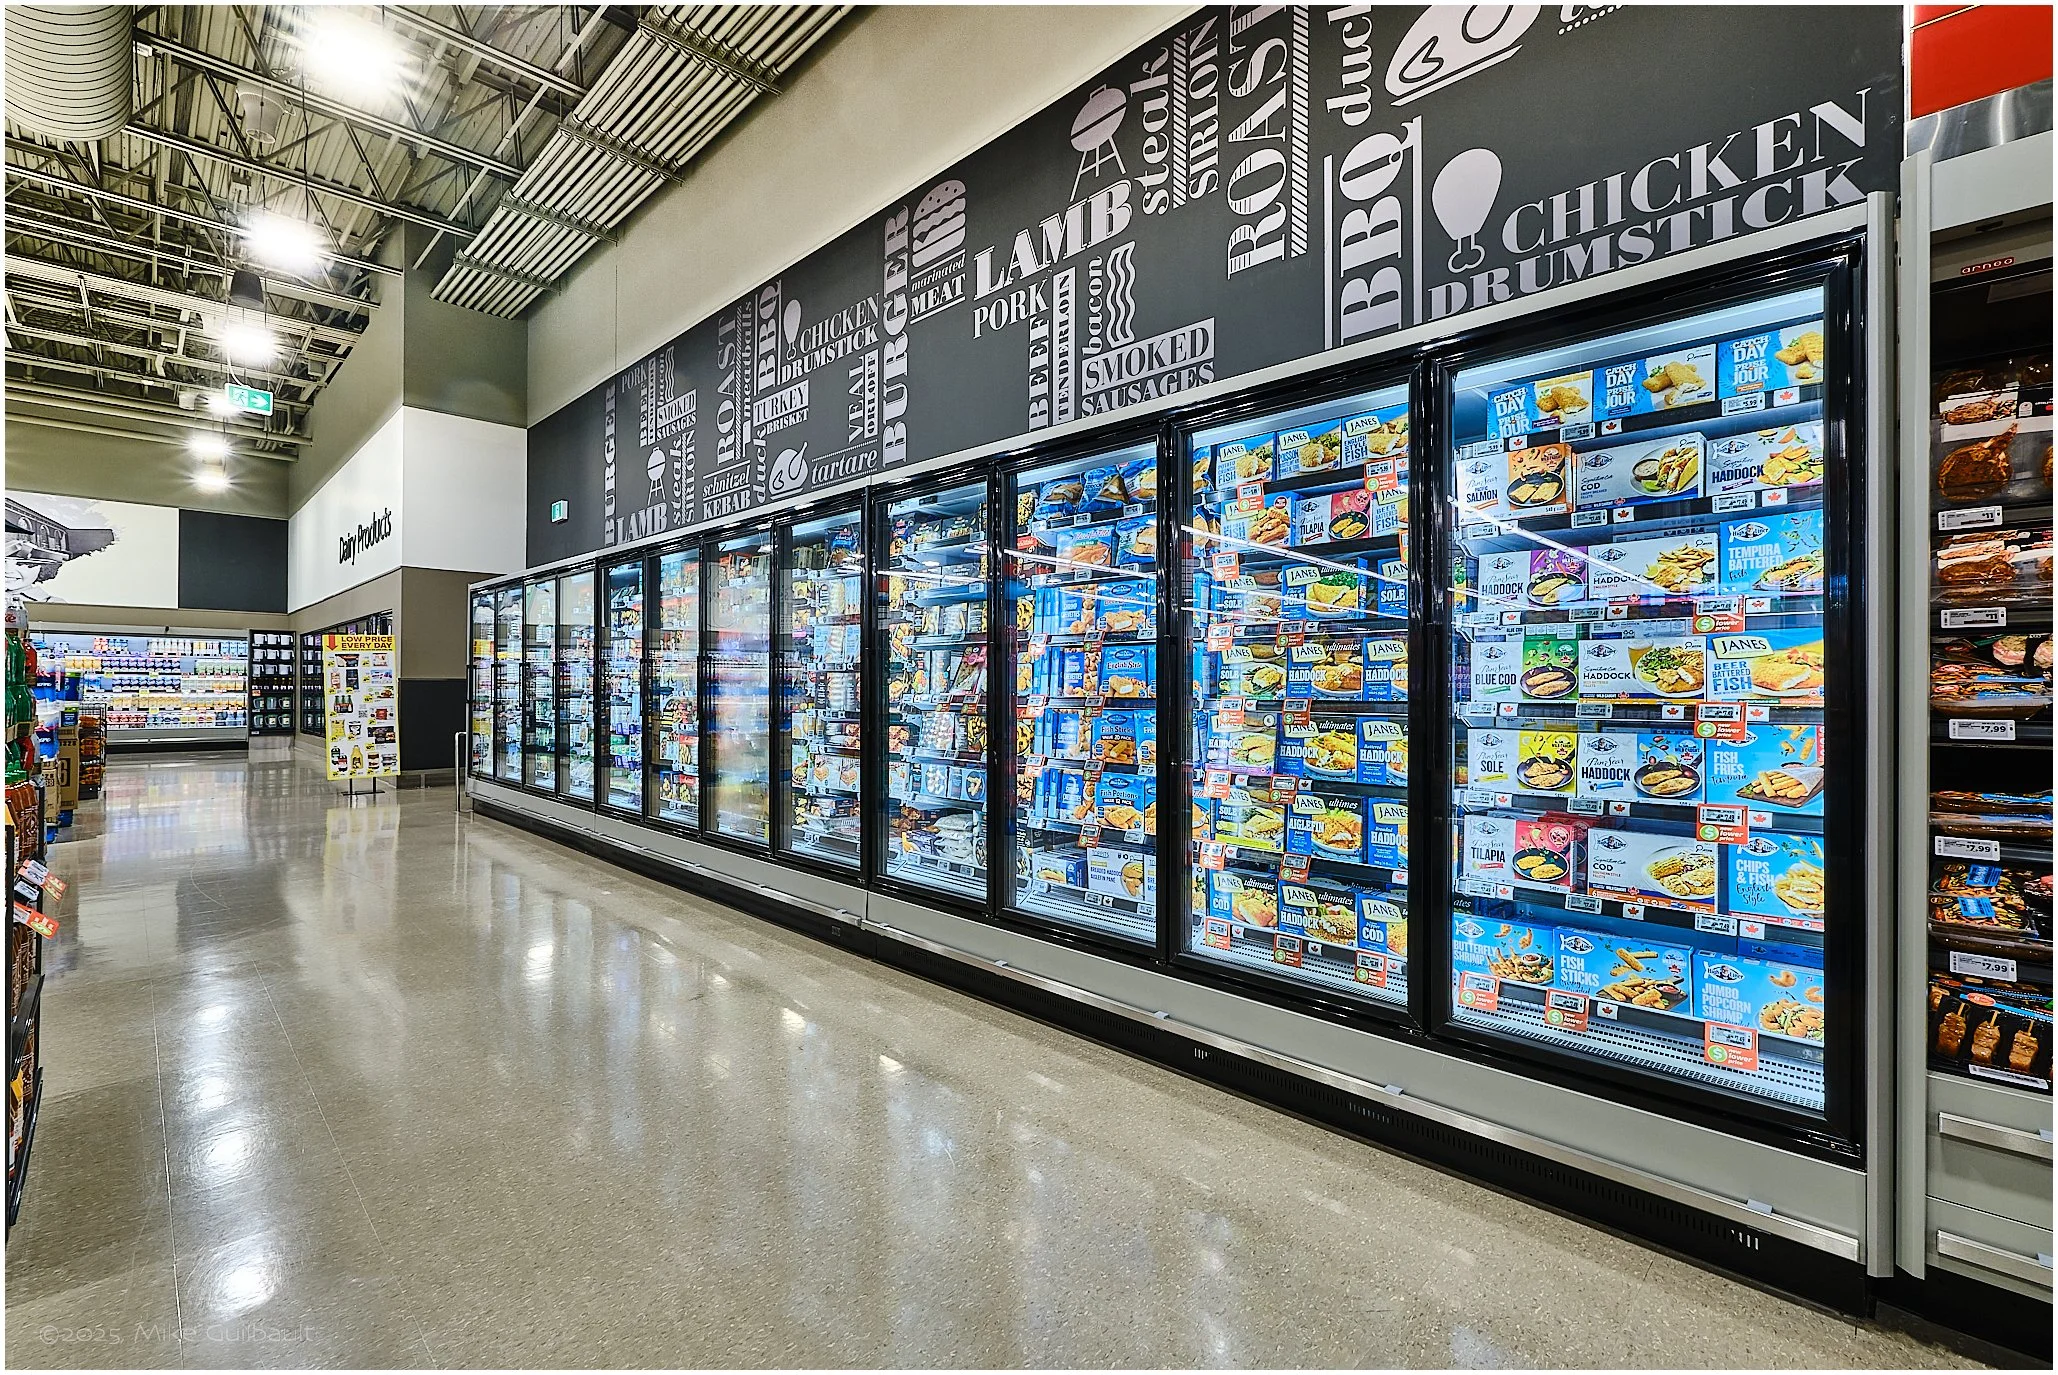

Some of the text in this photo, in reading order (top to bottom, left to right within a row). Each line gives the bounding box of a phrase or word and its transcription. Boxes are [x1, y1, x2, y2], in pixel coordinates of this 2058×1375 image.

[1189, 15, 1219, 200] SIRLOIN
[1129, 46, 1169, 216] steak
[1228, 5, 1288, 279] ROAST
[1501, 87, 1872, 255] CHICKEN
[1339, 116, 1421, 344] BBQ
[972, 178, 1134, 301] LAMB
[1427, 157, 1867, 321] DRUMSTICK
[911, 254, 966, 293] marinated
[911, 274, 966, 316] MEAT
[972, 279, 1050, 340] PORK
[1082, 255, 1103, 356] bacon
[800, 294, 880, 354] CHICKEN
[757, 280, 781, 396] BBQ
[882, 205, 910, 467] BURGER
[1732, 335, 1770, 349] CATCH
[781, 323, 879, 385] DRUMSTICK
[1058, 273, 1070, 421] TENDERLOIN
[1733, 342, 1767, 363] DAY
[742, 300, 752, 419] meatballs
[1085, 325, 1211, 391] SMOKED
[1028, 317, 1050, 433] BEEF
[1605, 363, 1637, 376] CATCH
[1733, 367, 1770, 386] JOUR
[621, 363, 648, 393] PORK
[1606, 370, 1635, 387] DAY
[716, 316, 736, 467] ROAST
[1081, 361, 1216, 419] SAUSAGES
[1493, 387, 1528, 404] CATCH
[755, 383, 808, 426] TURKEY
[848, 356, 866, 443] VEAL
[1496, 394, 1526, 417] DAY
[1605, 391, 1636, 410] JOUR
[657, 392, 696, 427] SMOKED
[656, 411, 697, 442] SAUSAGES
[767, 407, 809, 435] BRISKET
[1349, 417, 1378, 432] JANES
[1282, 432, 1308, 447] JANES
[1344, 434, 1367, 447] ENGLISH
[1223, 446, 1244, 458] JANES
[1344, 448, 1368, 462] FISH
[604, 384, 616, 547] BURGER
[751, 425, 767, 504] duck
[810, 450, 878, 485] tartare
[670, 434, 682, 526] steak
[685, 429, 695, 524] SIRLOIN
[703, 464, 750, 499] schnitzel
[1218, 472, 1236, 484] FISH
[1711, 463, 1765, 484] HADDOCK
[1580, 482, 1600, 492] COD
[1466, 489, 1498, 503] SALMON
[703, 488, 751, 522] KEBAB
[615, 501, 668, 545] LAMB
[1375, 516, 1399, 532] FISH
[339, 507, 392, 566] Dairy Products
[1727, 542, 1781, 560] TEMPURA
[1728, 555, 1784, 571] BATTERED
[1290, 568, 1318, 584] JANES
[1380, 588, 1406, 602] SOLE
[1481, 582, 1524, 596] HADDOCK
[1715, 619, 1739, 627] lower
[1226, 650, 1250, 659] JANES
[1296, 646, 1323, 658] JANES
[1326, 642, 1361, 652] ultimates
[1372, 642, 1404, 656] JANES
[1722, 639, 1767, 655] JANES
[1712, 668, 1751, 678] BATTERED
[1713, 661, 1747, 671] BEER
[1220, 670, 1239, 680] SOLE
[1288, 670, 1327, 682] HADDOCK
[1365, 670, 1409, 681] HADDOCK
[1475, 673, 1517, 685] BLUE COD
[1583, 672, 1631, 680] HADDOCK
[1713, 676, 1752, 692] FISH
[1318, 719, 1355, 731] ultimates
[1369, 724, 1401, 737] JANES
[1981, 725, 2006, 733] $7.99
[1280, 745, 1319, 759] HADDOCK
[1360, 749, 1404, 763] HADDOCK
[1713, 751, 1738, 763] FISH
[1480, 761, 1504, 774] SOLE
[1581, 767, 1631, 781] HADDOCK
[1713, 762, 1744, 775] FRIES
[1219, 806, 1238, 816] SOLE
[1295, 796, 1324, 810] JANES
[1328, 799, 1359, 810] ultimes
[1378, 806, 1408, 819] JANES
[1289, 816, 1325, 833] AIGLEFIN
[1471, 846, 1506, 863] TILAPIA
[1966, 844, 1991, 853] $7.99
[1593, 863, 1614, 872] COD
[1736, 859, 1770, 874] CHIPS
[1243, 878, 1276, 891] ultimates
[1736, 873, 1775, 887] & FISH
[1287, 888, 1315, 902] JANES
[1318, 892, 1354, 906] ultimates
[1213, 898, 1230, 911] COD
[1368, 902, 1399, 918] JANES
[1280, 911, 1319, 930] HADDOCK
[1362, 926, 1385, 943] COD
[1453, 940, 1498, 957] BUTTERFLY
[1453, 952, 1485, 965] SHRIMP
[1560, 954, 1585, 972] FISH
[1982, 961, 2008, 974] $7.99
[1560, 967, 1600, 988] STICKS
[1702, 983, 1739, 1000] JUMBO
[1475, 996, 1494, 1004] lower
[1702, 994, 1752, 1014] POPCORN
[1564, 1015, 1583, 1025] lower
[1702, 1006, 1743, 1023] SHRIMP
[1728, 1053, 1753, 1062] lower
